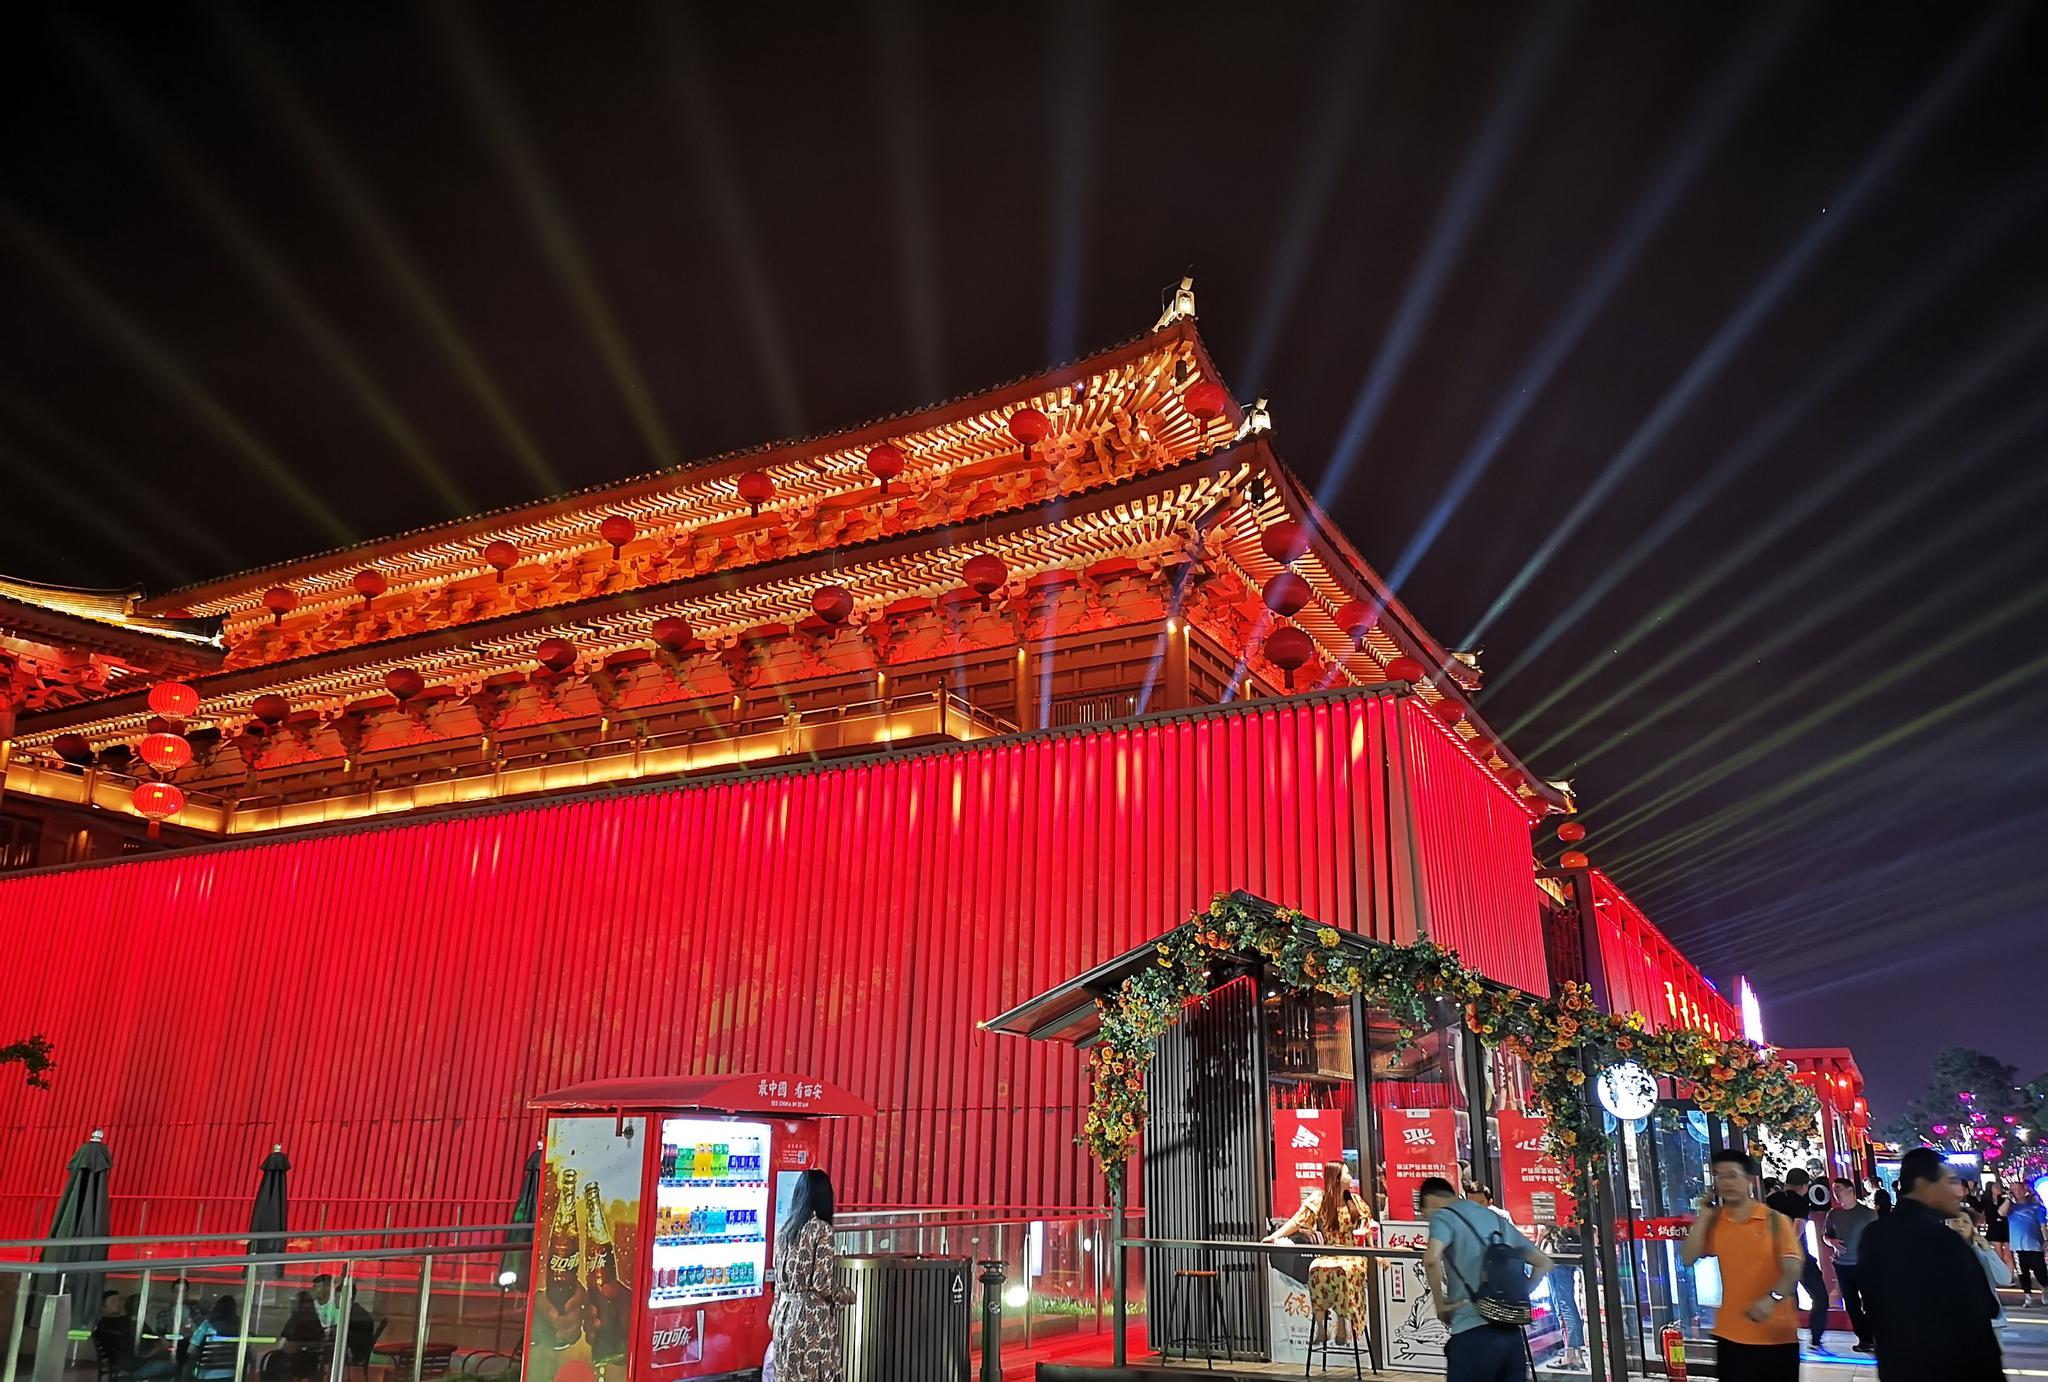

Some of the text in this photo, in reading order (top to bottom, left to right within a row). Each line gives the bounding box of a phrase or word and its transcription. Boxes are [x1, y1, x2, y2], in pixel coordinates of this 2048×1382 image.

[758, 1079, 823, 1100] 最中國 看西安
[652, 1326, 695, 1352] 可口可乐
